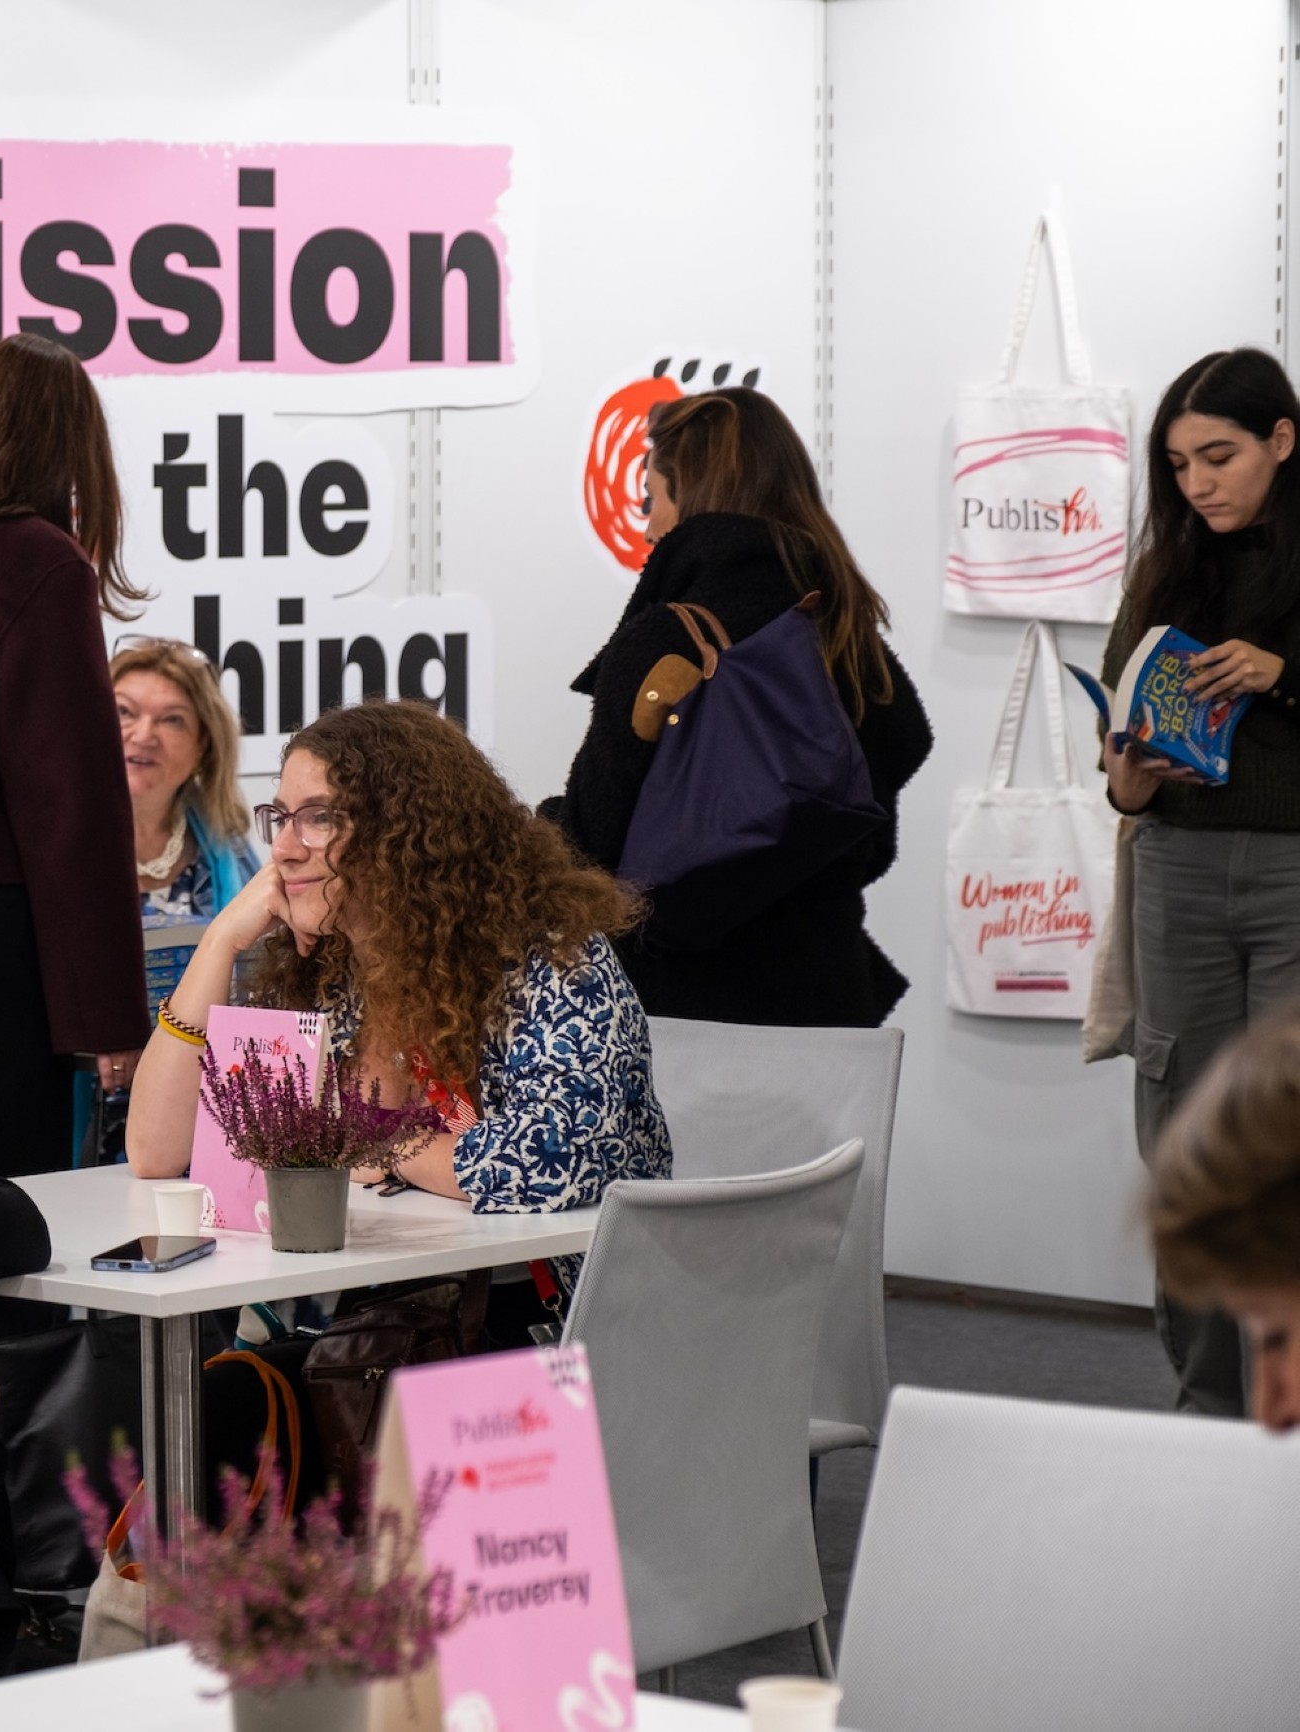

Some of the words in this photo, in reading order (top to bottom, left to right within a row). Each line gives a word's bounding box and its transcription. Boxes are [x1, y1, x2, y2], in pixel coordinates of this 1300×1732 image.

[153, 414, 370, 561] the
[1148, 656, 1179, 709] JOB
[1159, 661, 1190, 734] SEARC
[961, 871, 1047, 908] Women
[1053, 867, 1081, 899] in
[977, 901, 1093, 955] publishing
[474, 1529, 568, 1567] Nancy
